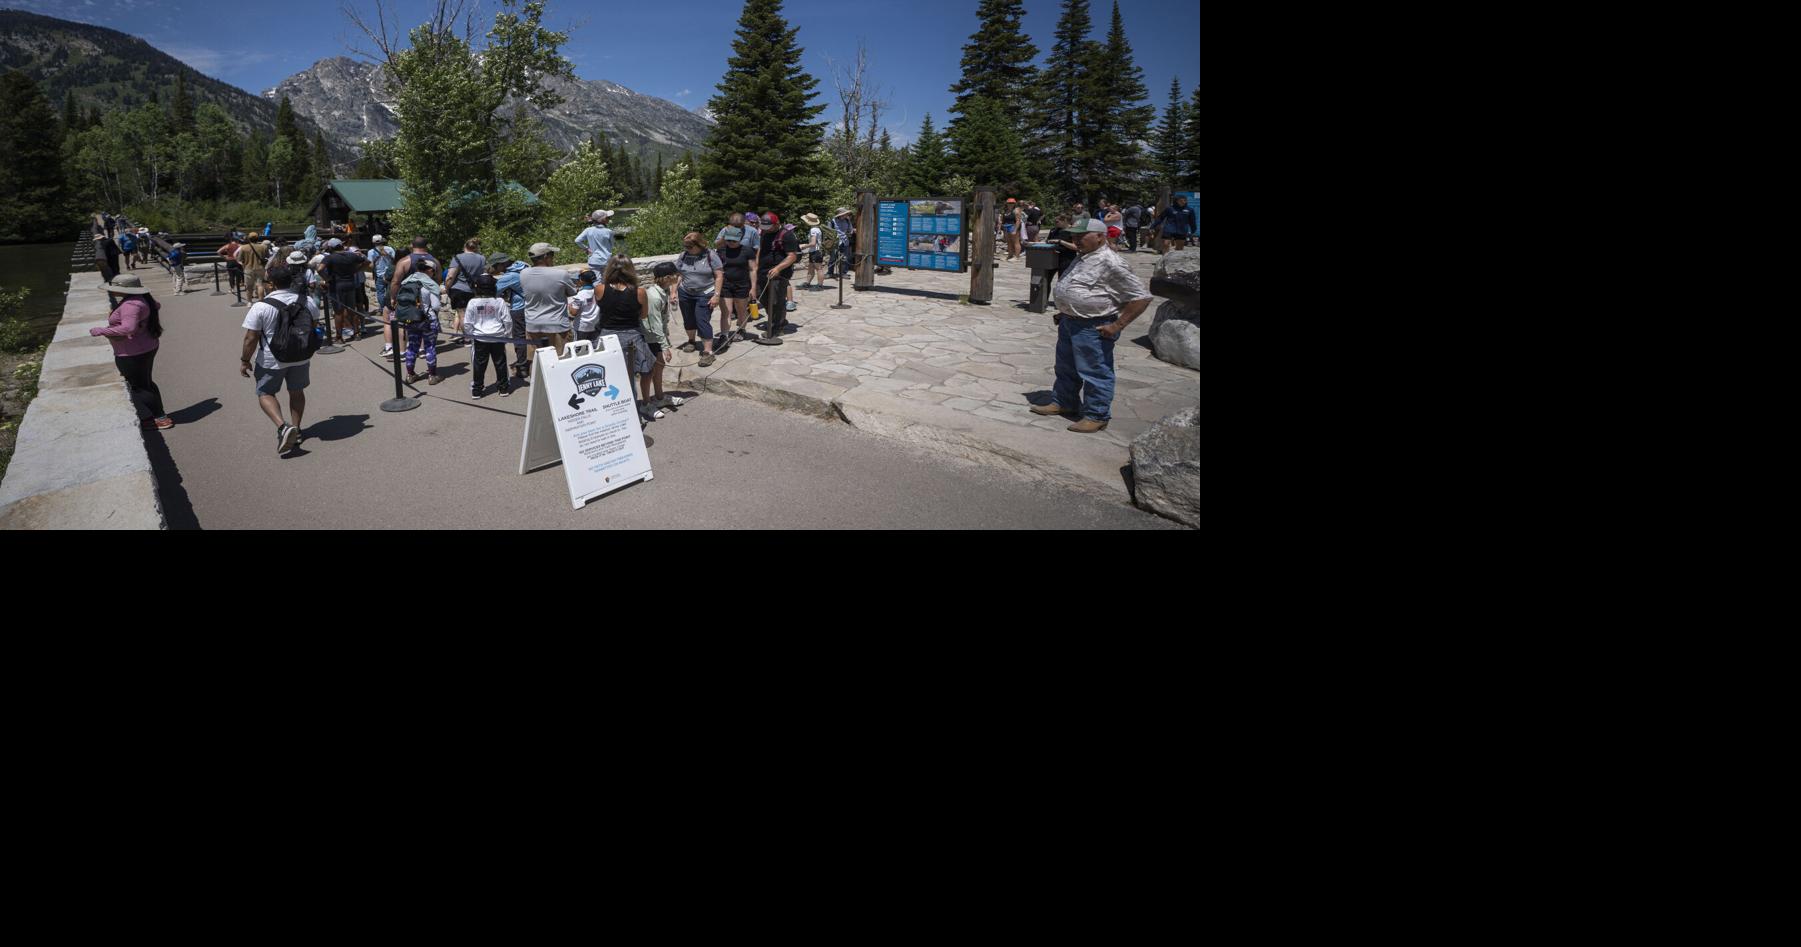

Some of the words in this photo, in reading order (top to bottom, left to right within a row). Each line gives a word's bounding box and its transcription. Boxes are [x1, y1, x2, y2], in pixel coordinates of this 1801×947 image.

[578, 381, 593, 393] JENNY
[593, 379, 606, 388] LAKE
[557, 411, 585, 422] LAKESHORE
